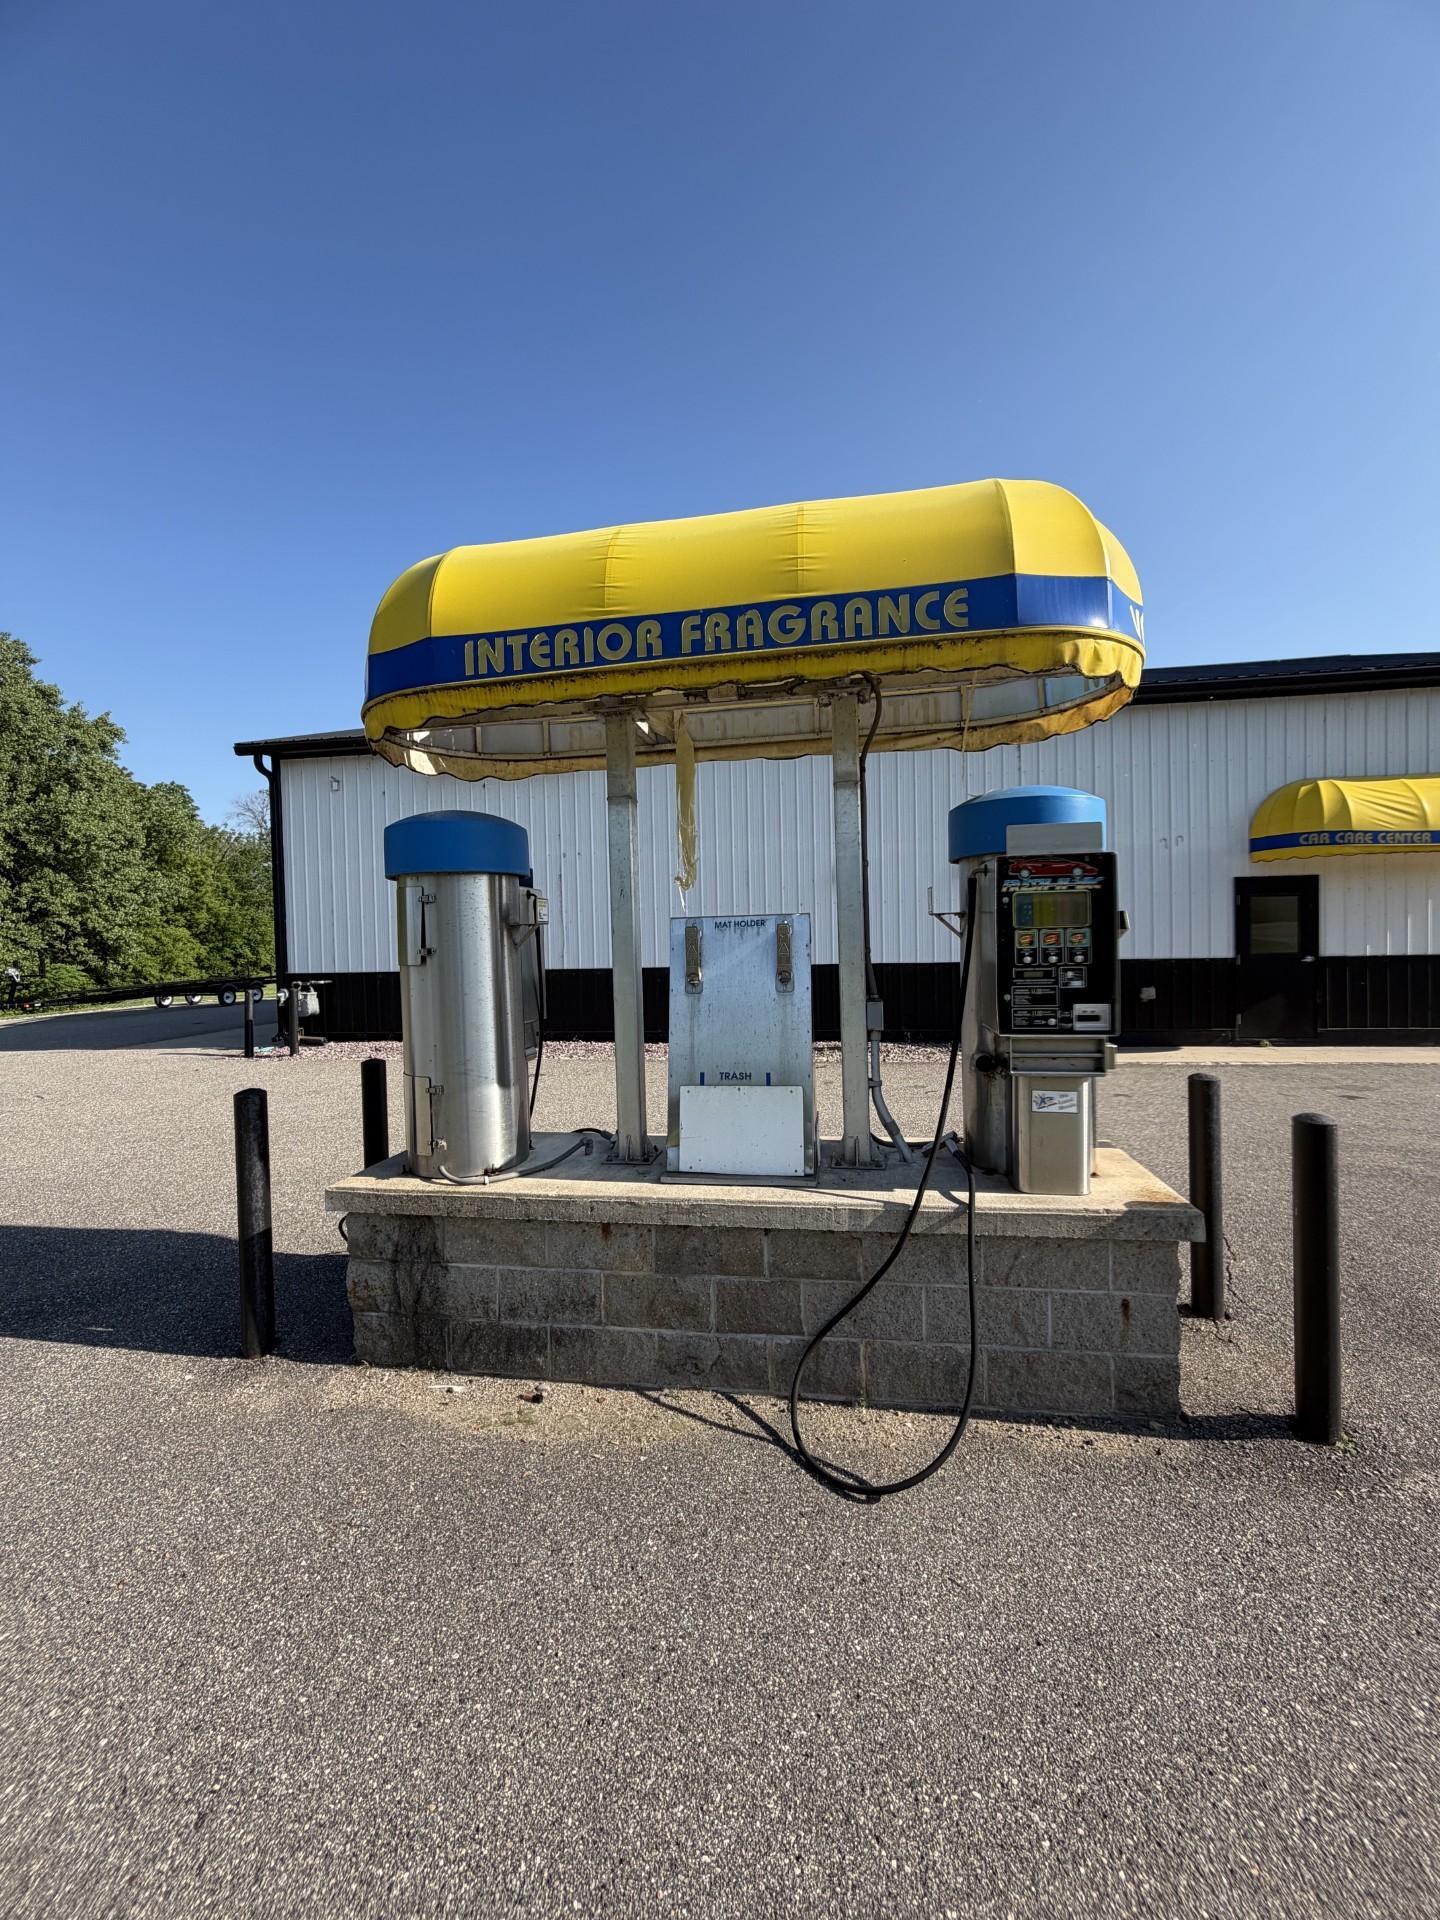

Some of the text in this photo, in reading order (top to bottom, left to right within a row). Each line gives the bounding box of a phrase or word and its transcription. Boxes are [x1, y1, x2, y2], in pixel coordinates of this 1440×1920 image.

[464, 587, 969, 676] INTERIOR FRAGRANCE
[1300, 832, 1431, 844] CAR CARE CENTER
[714, 919, 766, 929] MAT HOLDER
[720, 1072, 752, 1080] TRASH
